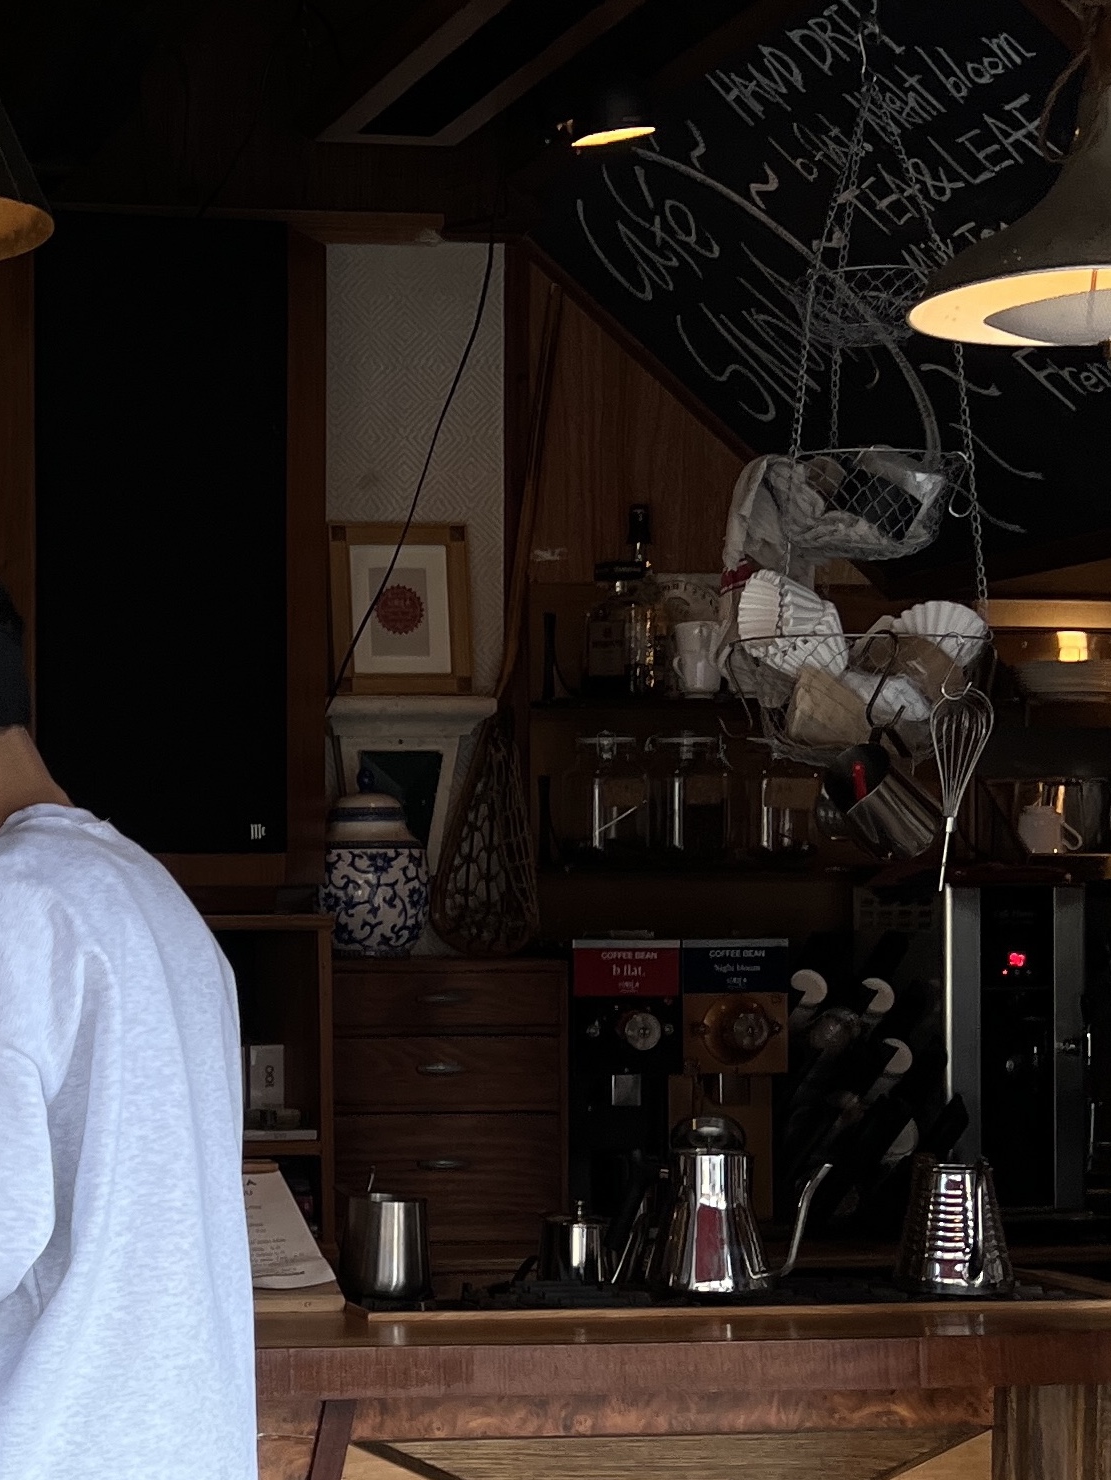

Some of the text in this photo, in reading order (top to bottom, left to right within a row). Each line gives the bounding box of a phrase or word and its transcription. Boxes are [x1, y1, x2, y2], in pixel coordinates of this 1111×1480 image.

[705, 44, 807, 127] HAND
[913, 33, 1037, 104] bloom
[601, 951, 658, 960] COFFEE BEAN
[708, 949, 766, 958] COFFEE BEAN
